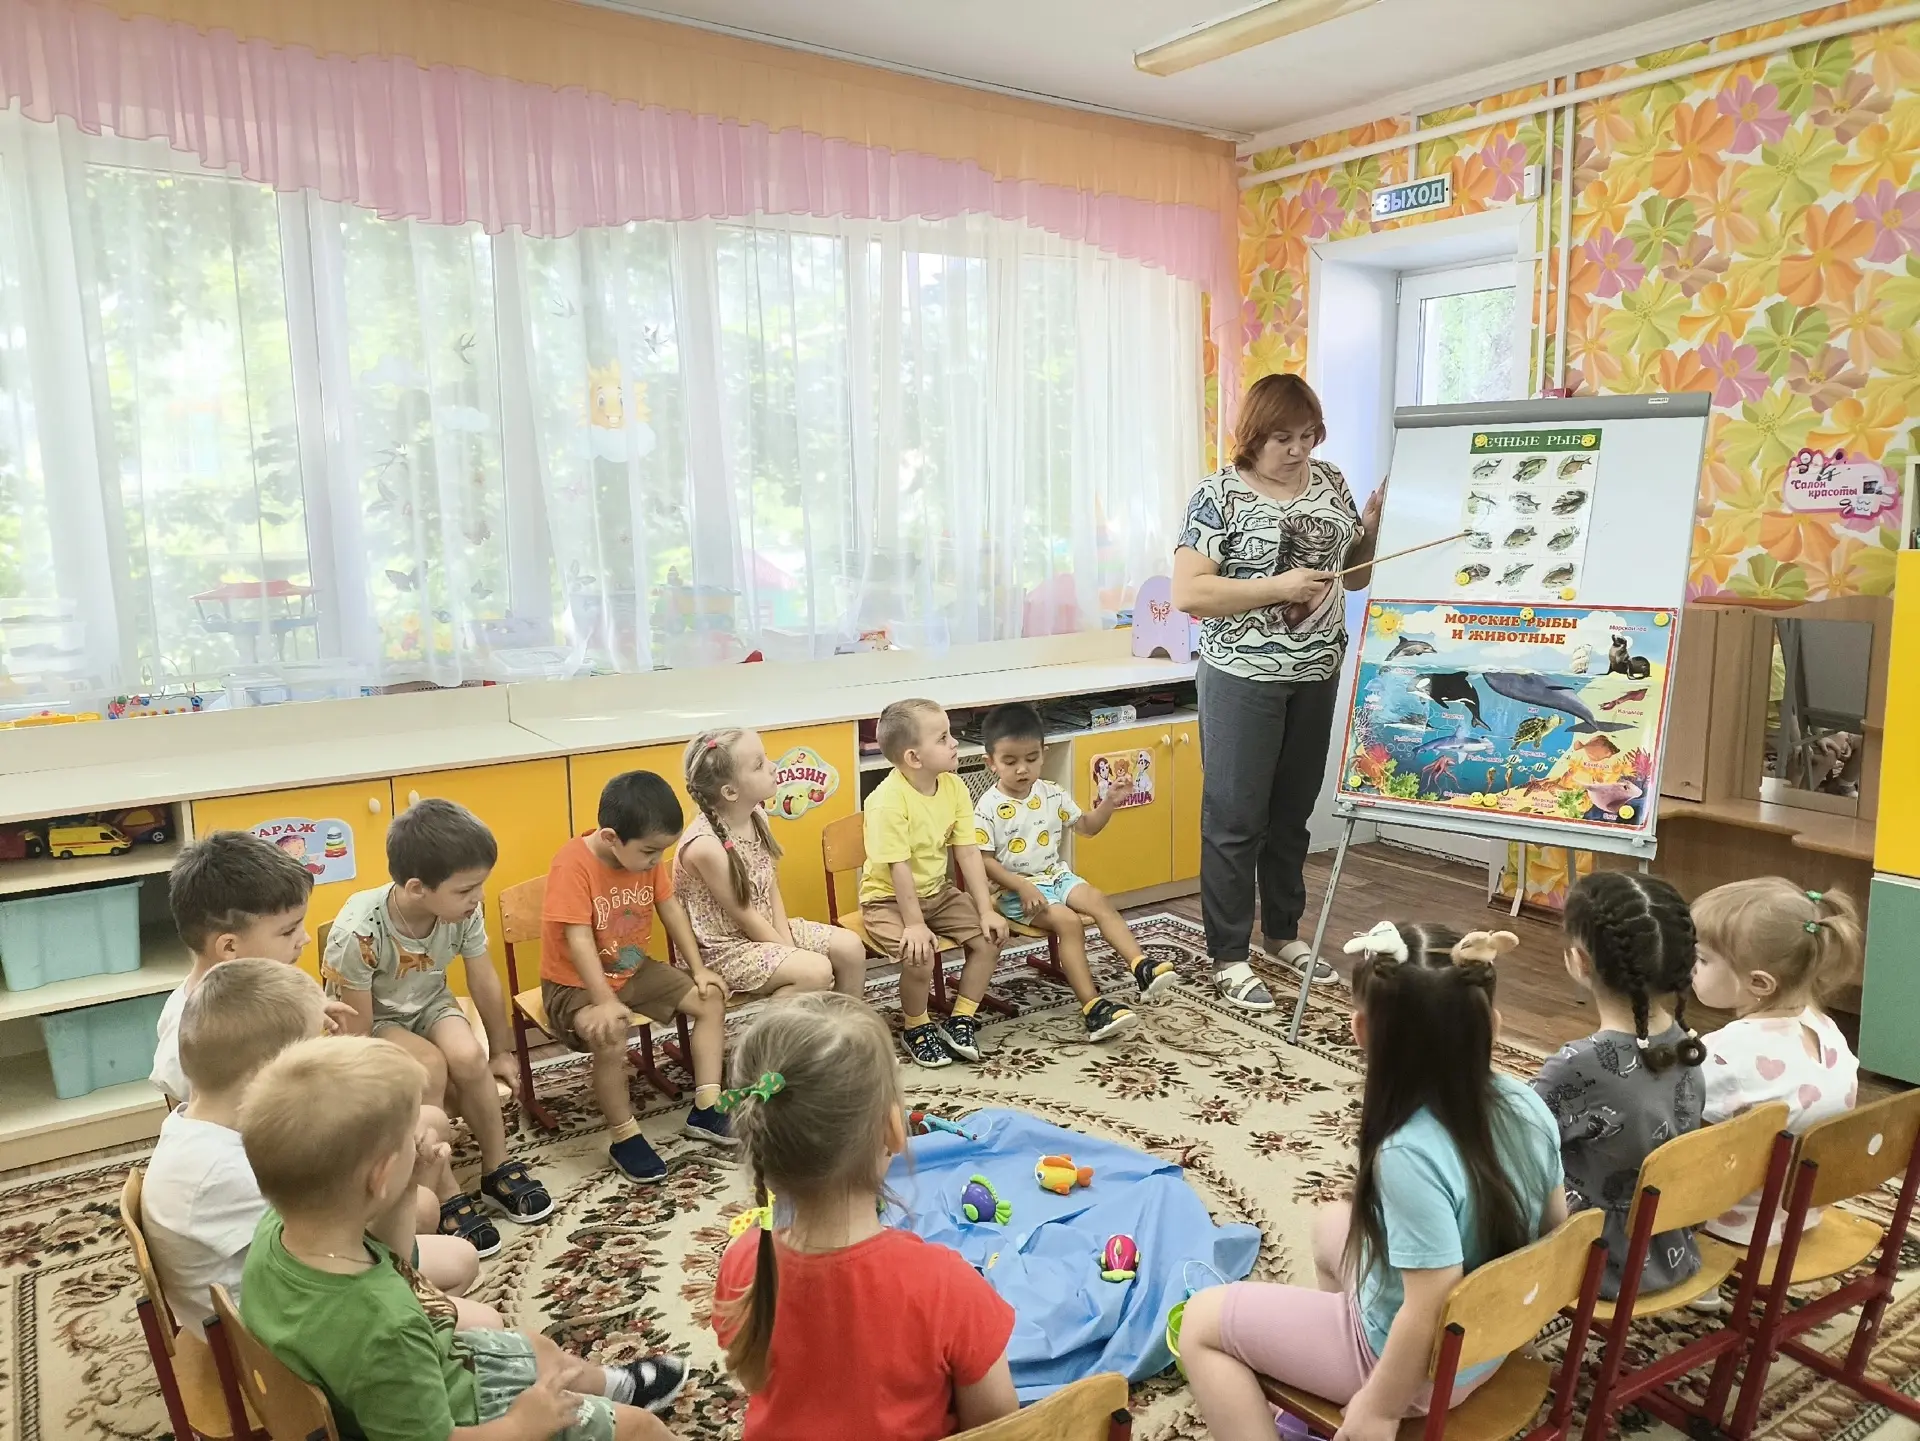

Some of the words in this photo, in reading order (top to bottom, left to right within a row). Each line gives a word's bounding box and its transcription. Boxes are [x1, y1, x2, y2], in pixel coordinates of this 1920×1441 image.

[1375, 182, 1443, 213] ВЫХОД
[1475, 436, 1540, 448] ЕЧНЫЕ
[1546, 434, 1597, 446] РЫБ
[1791, 480, 1826, 490] Салон
[1808, 486, 1858, 499] красоты
[1444, 613, 1521, 627] МОРСКИЕ
[1526, 616, 1578, 629] РЫБЫ
[1452, 629, 1464, 640] И
[1468, 630, 1566, 645] ЖИВОТНЫЕ
[776, 767, 827, 785] ГАЗИН
[251, 823, 317, 838] АРАЖ
